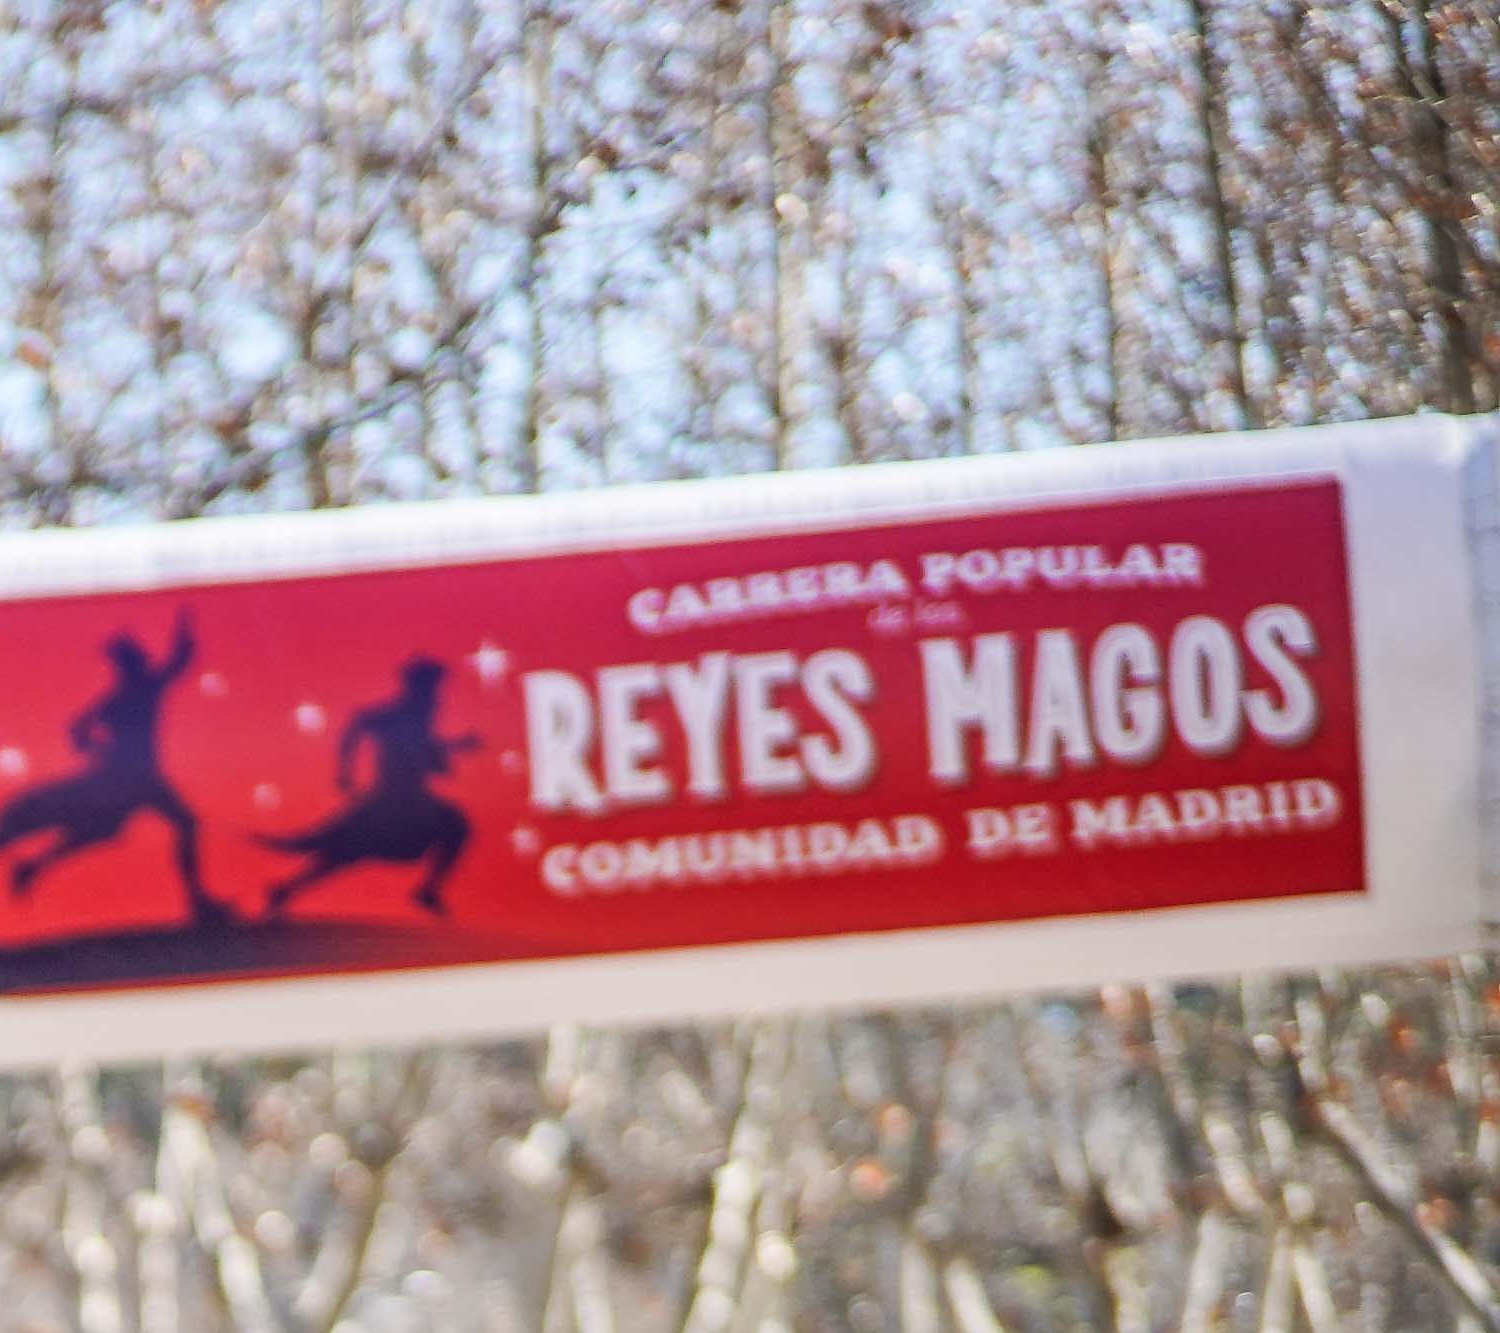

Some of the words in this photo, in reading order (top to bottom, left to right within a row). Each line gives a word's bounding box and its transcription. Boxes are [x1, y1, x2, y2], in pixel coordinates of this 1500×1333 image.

[628, 560, 907, 634] CARRERA
[920, 544, 1203, 593] POPULAR
[523, 648, 875, 816] REYES
[919, 603, 1321, 789] MAGOS
[541, 814, 941, 894] COMUNIDAD
[966, 804, 1057, 858] DE
[1071, 777, 1342, 848] MADRID
